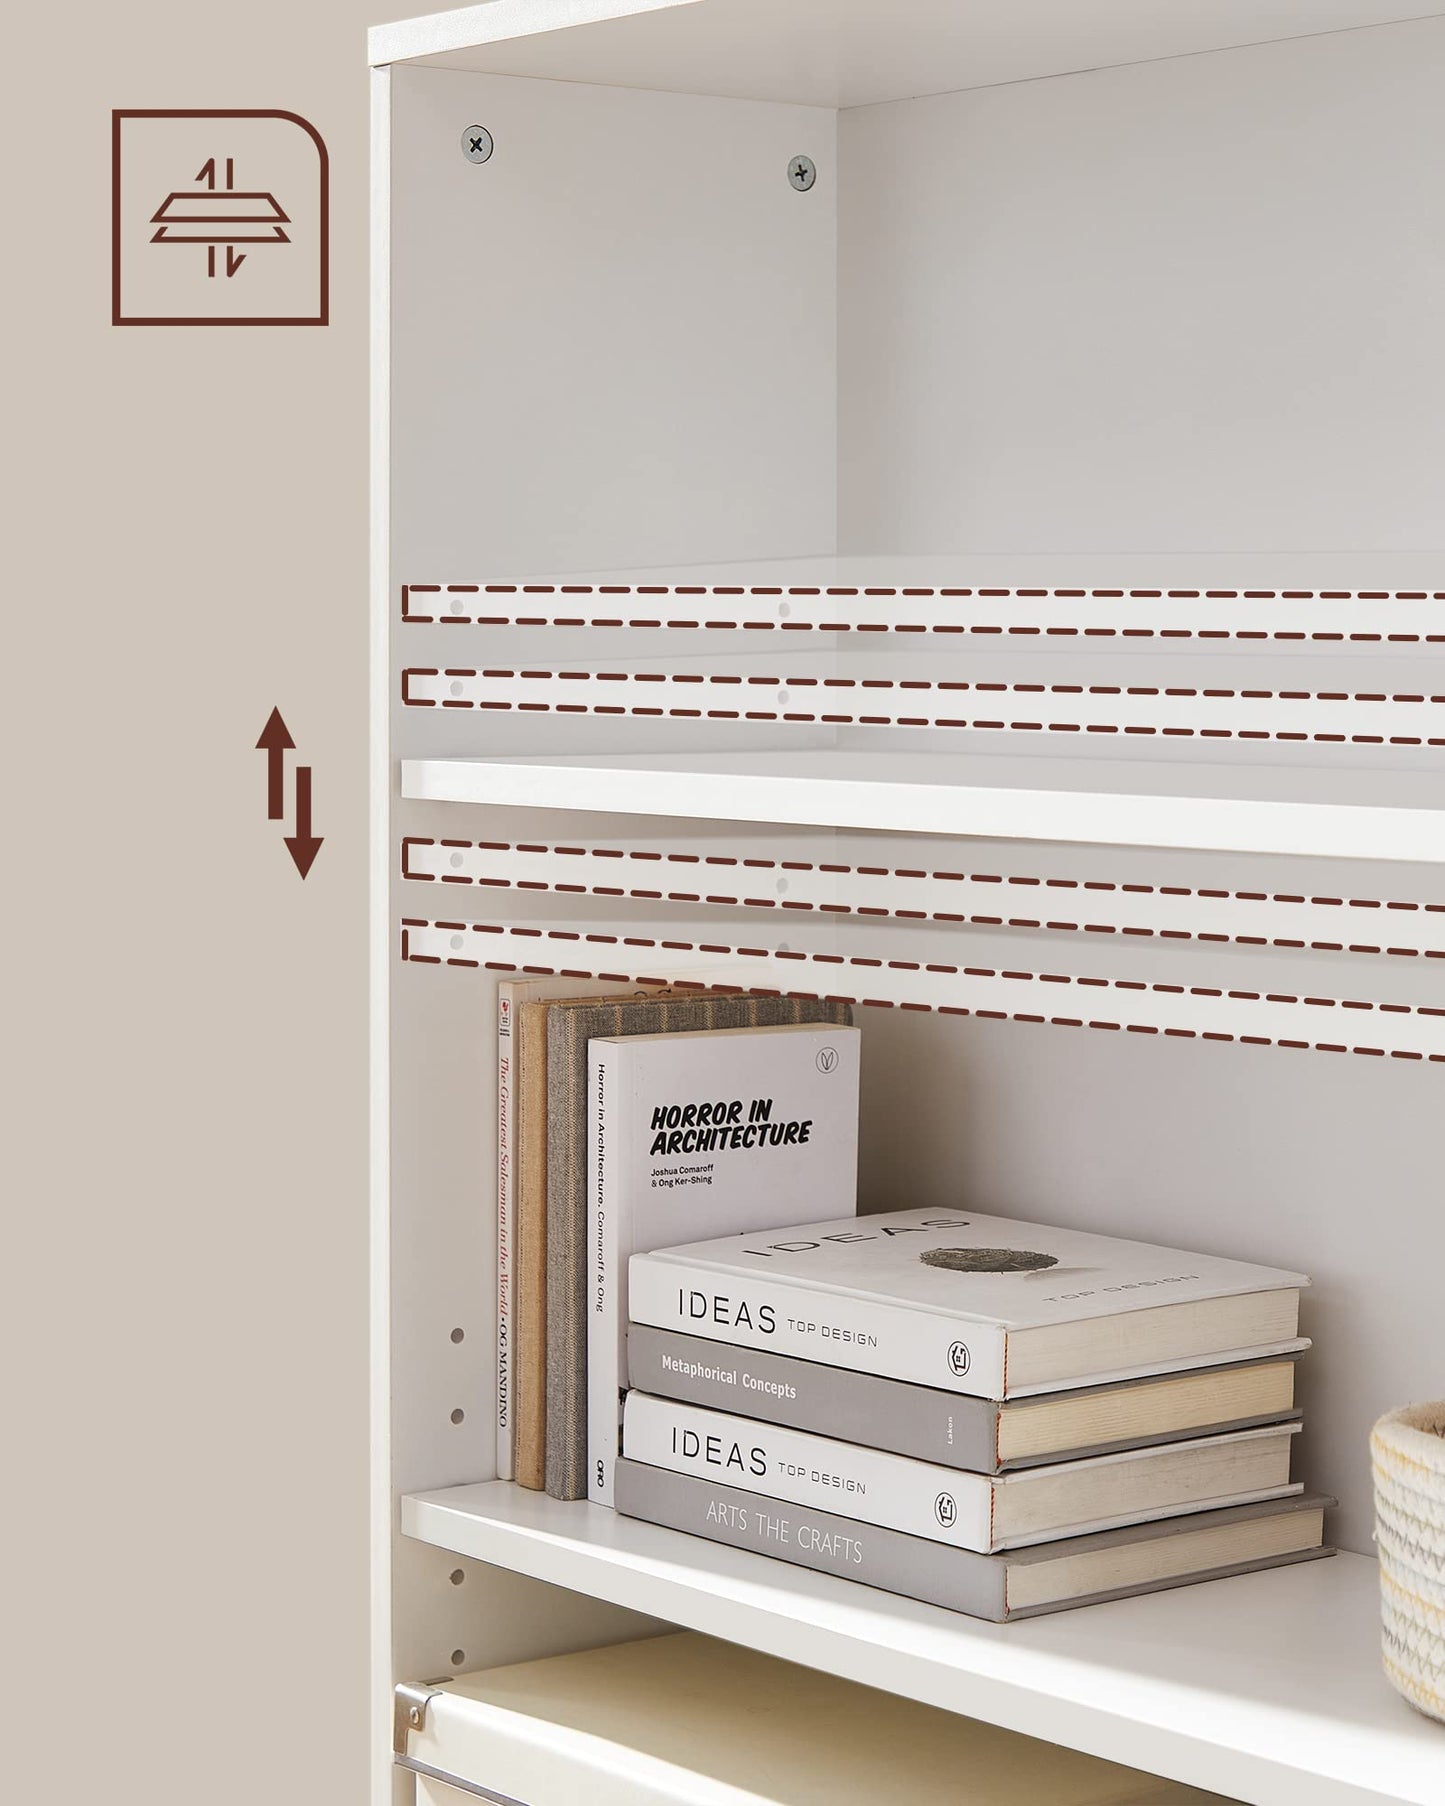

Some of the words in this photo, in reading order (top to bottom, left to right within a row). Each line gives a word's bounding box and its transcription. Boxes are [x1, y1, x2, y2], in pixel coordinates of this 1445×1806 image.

[500, 1058, 509, 1083] The
[597, 1064, 605, 1106] Horror
[500, 1086, 509, 1149] Greatest
[598, 1109, 605, 1121] in
[650, 1100, 743, 1130] HORROR
[748, 1098, 773, 1123] IN
[649, 1120, 813, 1156] ARCHITECTURE
[500, 1152, 509, 1225] Salesman
[651, 1168, 678, 1177] Joshua
[679, 1164, 714, 1174] Comaroff
[658, 1178, 674, 1188] Ong
[674, 1175, 713, 1186] Ker-Shing
[500, 1229, 508, 1243] in
[597, 1211, 605, 1271] Comaroff
[742, 1218, 970, 1257] IDEAS
[500, 1246, 508, 1269] the
[500, 1274, 508, 1316] World
[597, 1274, 605, 1284] &
[1041, 1291, 1095, 1302] TOP
[1102, 1274, 1200, 1293] DESIGN
[596, 1287, 605, 1313] Ong
[678, 1288, 777, 1335] IDEAS
[787, 1318, 817, 1334] TOP
[821, 1325, 879, 1348] DESIGN
[500, 1324, 508, 1348] OG
[499, 1352, 507, 1428] MANDINO
[661, 1354, 737, 1386] Metaphorical
[742, 1373, 797, 1400] Concepts
[671, 1426, 768, 1477] IDEAS
[778, 1461, 807, 1478] TOP
[811, 1470, 867, 1495] DESIGN
[706, 1500, 748, 1531] ARTS
[755, 1512, 790, 1543] THE
[797, 1525, 863, 1565] CRAFTS
